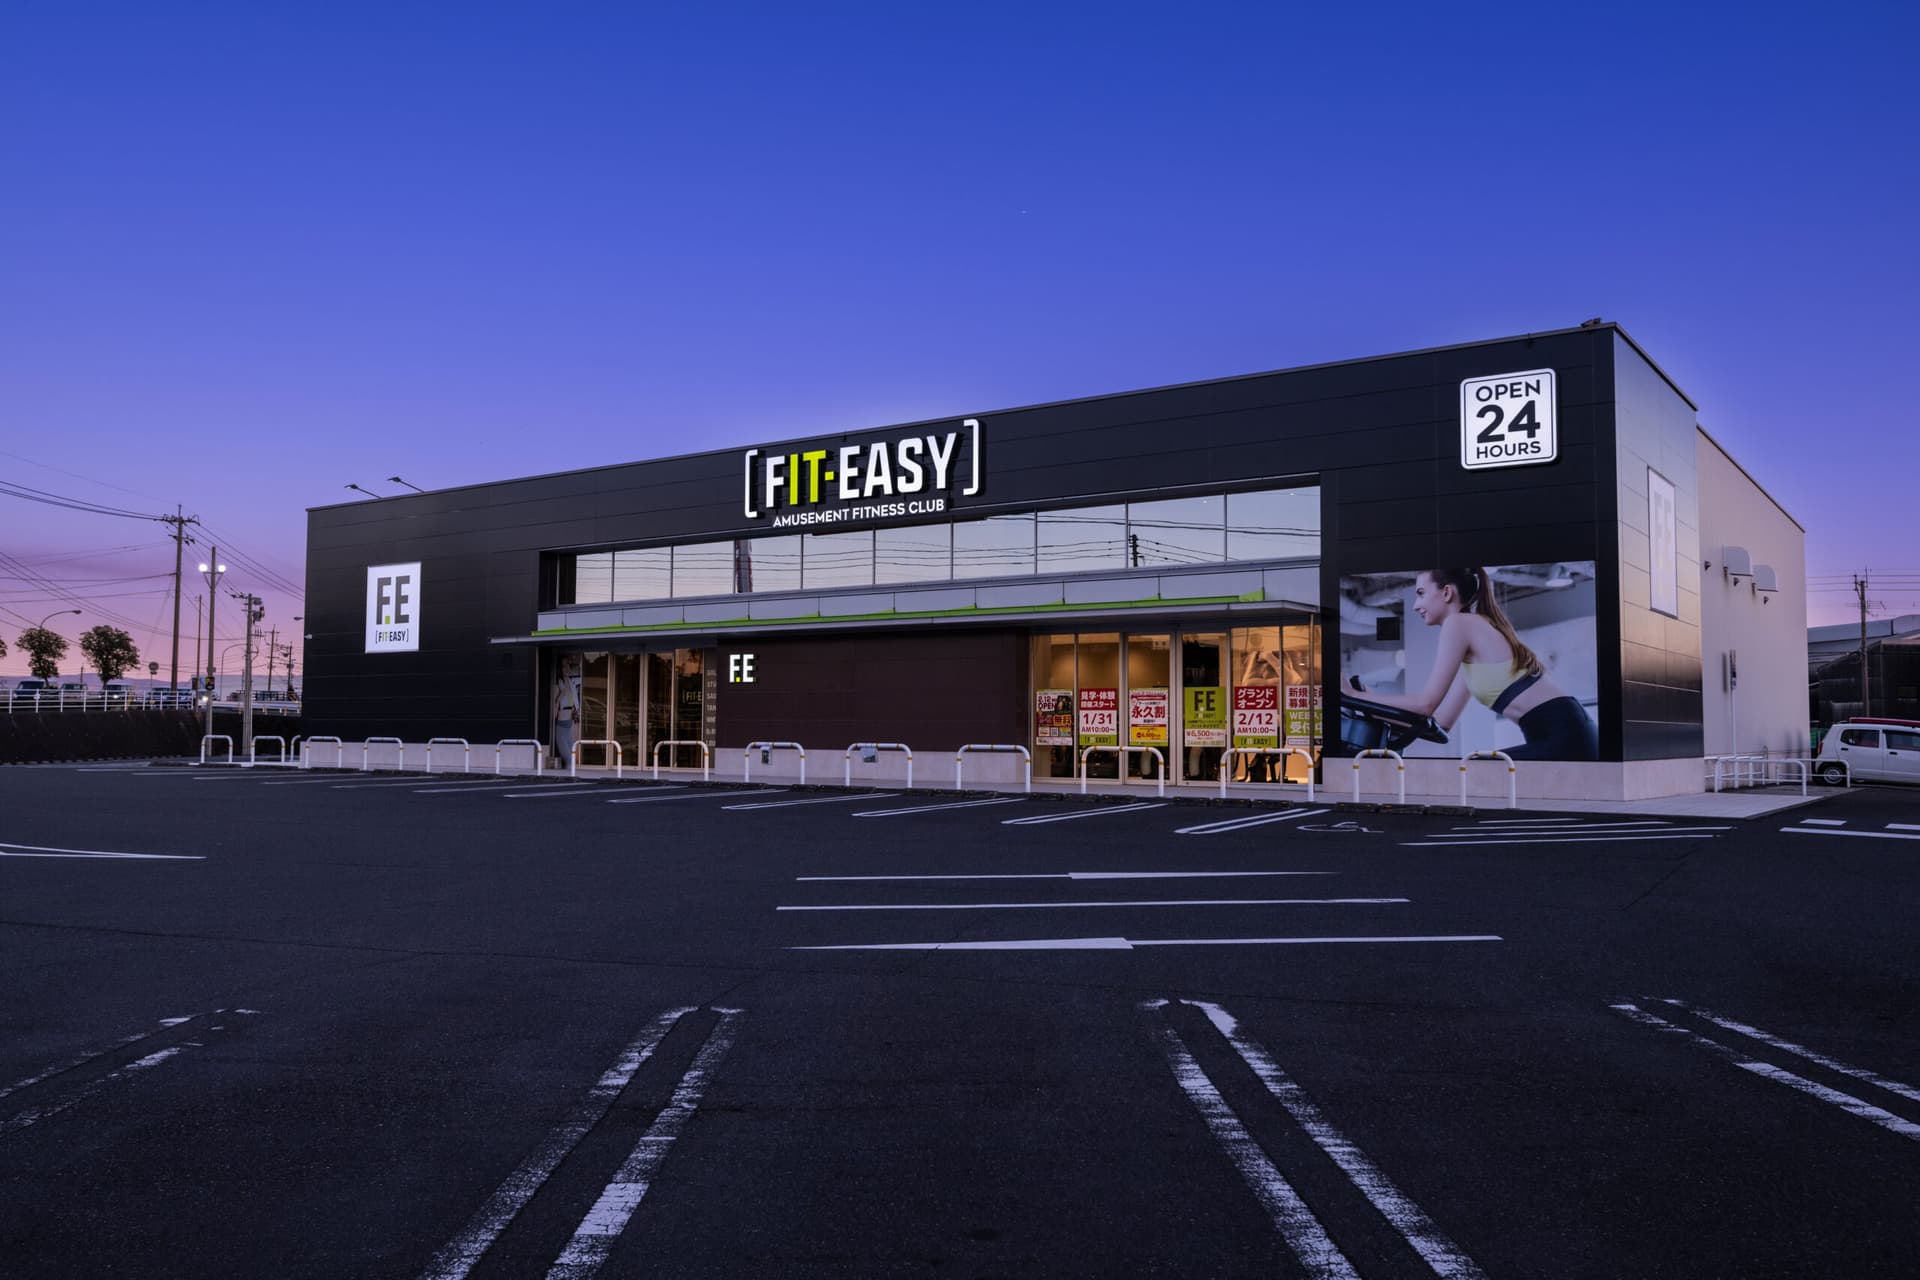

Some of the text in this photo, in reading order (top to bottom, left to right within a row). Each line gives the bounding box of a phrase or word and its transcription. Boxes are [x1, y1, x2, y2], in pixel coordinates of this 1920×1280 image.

[1475, 379, 1541, 402] OPEN
[1476, 400, 1541, 444] 24
[1476, 441, 1541, 459] HOURS
[773, 499, 945, 528] AMUSEMENT FITNESS CLUB
[1238, 688, 1274, 698] グランド
[1038, 702, 1056, 710] OPEN
[1237, 699, 1274, 709] オープン
[1083, 712, 1113, 725] 1/31
[1131, 705, 1166, 719] 永久割
[1238, 712, 1273, 726] 2/12
